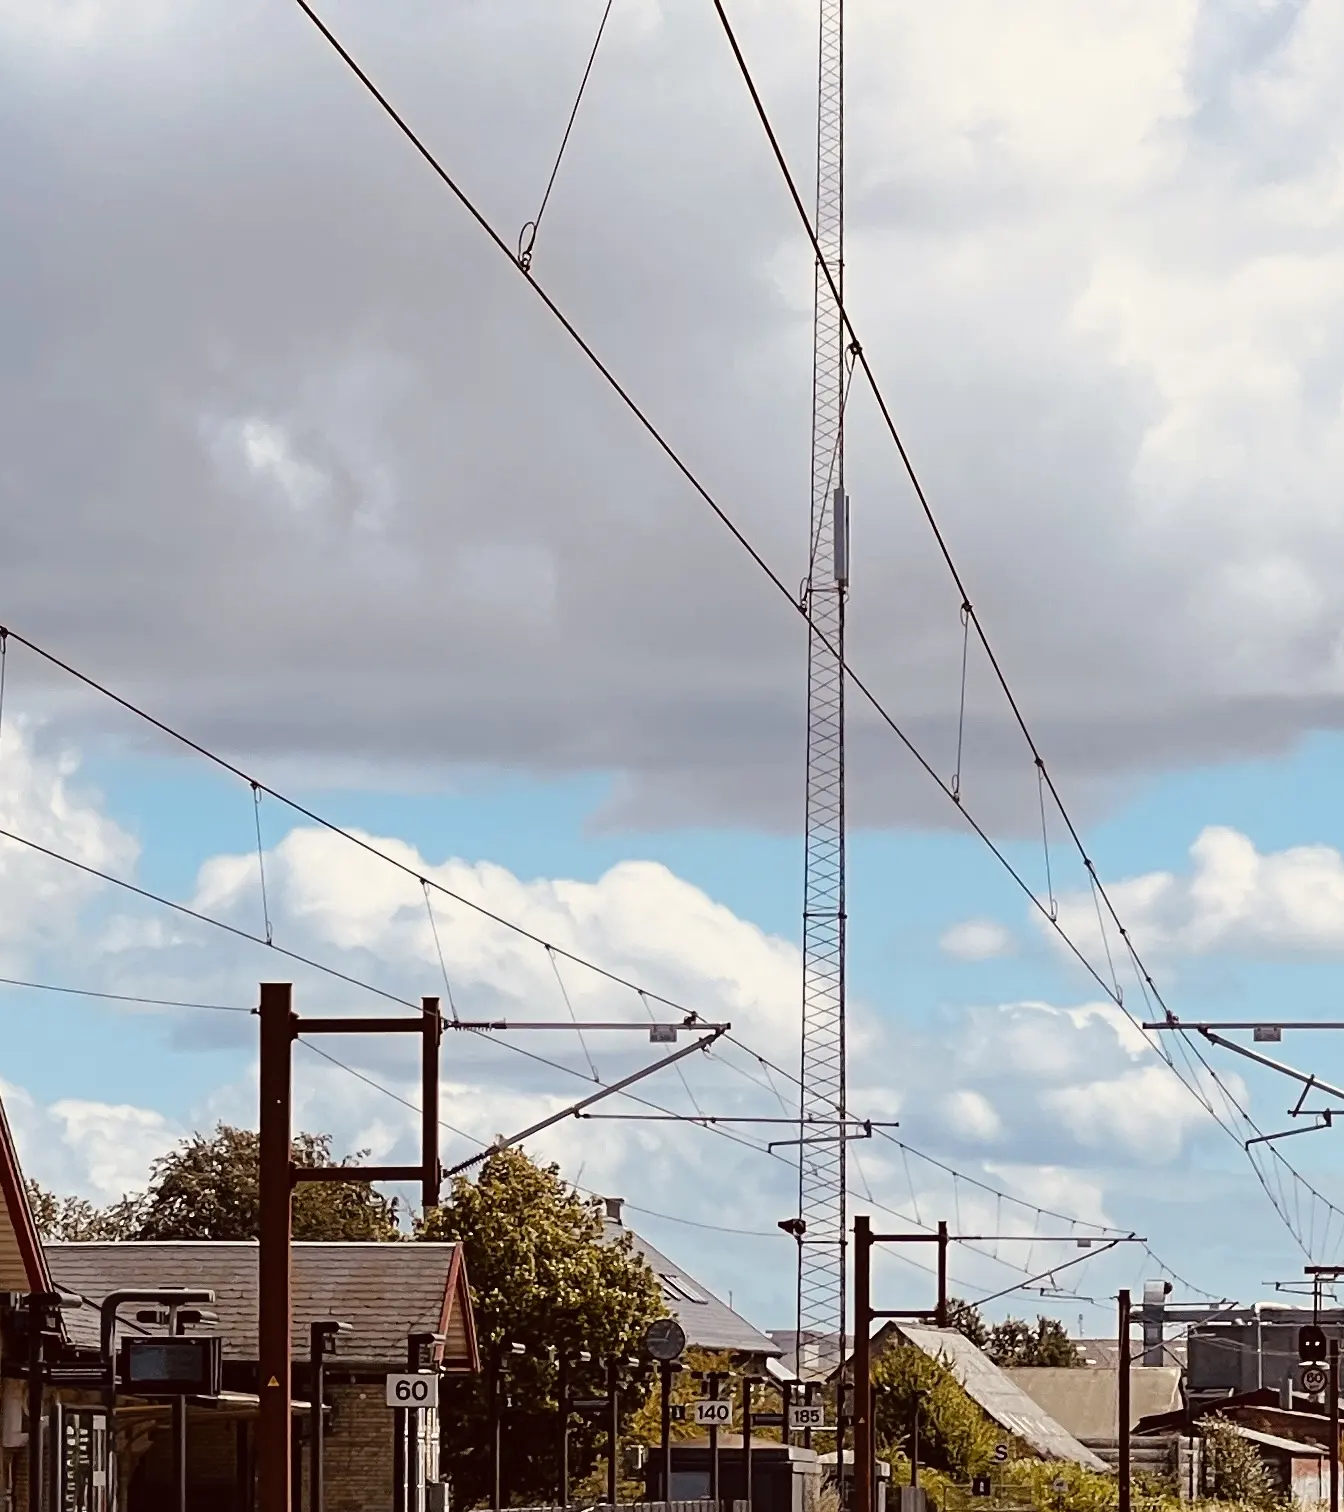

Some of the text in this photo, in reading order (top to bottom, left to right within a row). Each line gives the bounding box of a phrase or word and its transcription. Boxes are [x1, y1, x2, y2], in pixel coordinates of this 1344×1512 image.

[1307, 1373, 1323, 1383] 60
[396, 1380, 428, 1400] 60
[697, 1405, 729, 1420] 140
[795, 1410, 819, 1423] 185
[996, 1445, 1008, 1460] S
